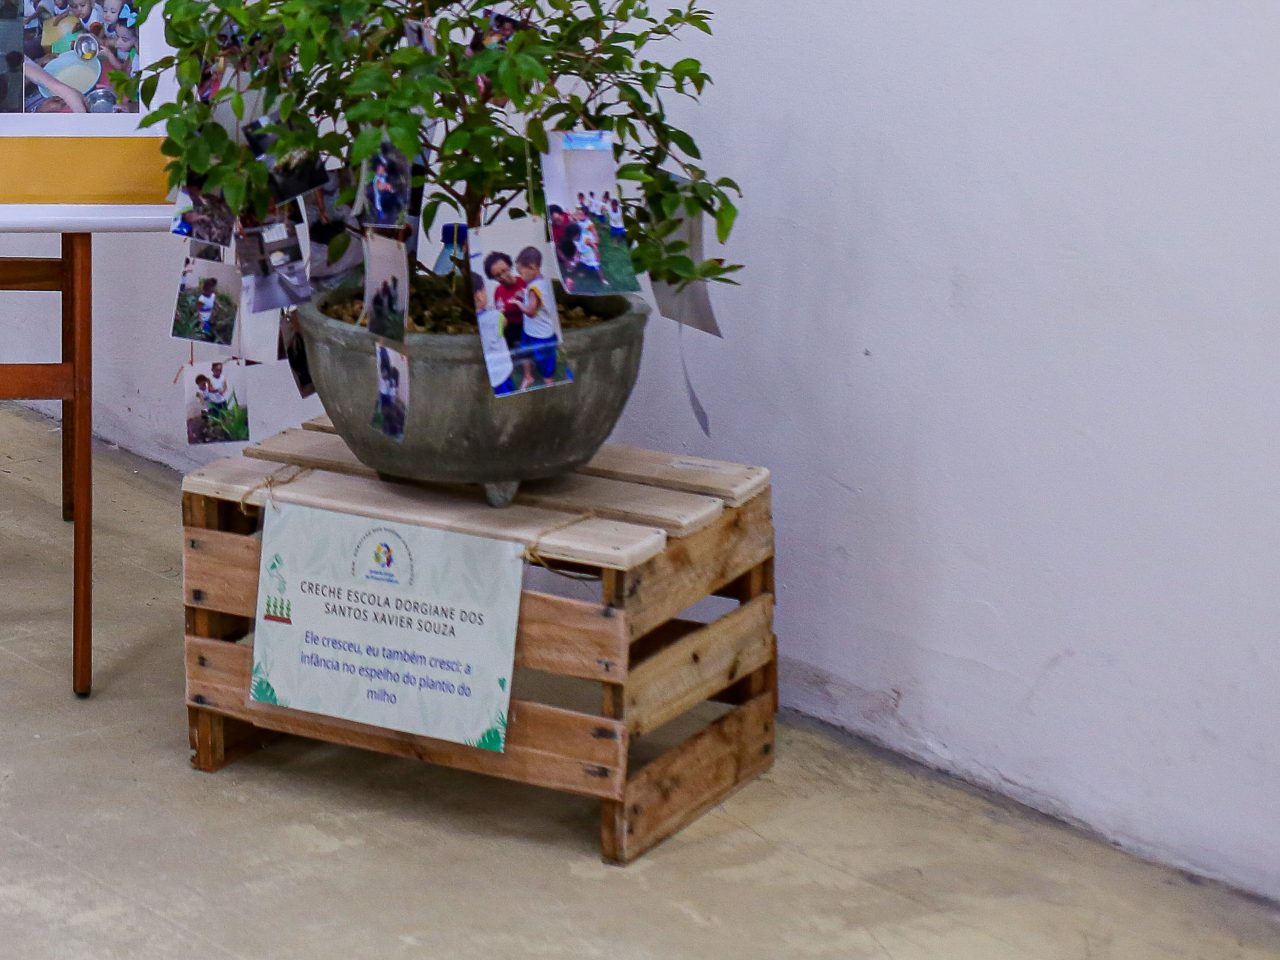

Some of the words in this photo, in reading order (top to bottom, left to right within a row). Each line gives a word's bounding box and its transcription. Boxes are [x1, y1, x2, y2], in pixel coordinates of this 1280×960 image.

[300, 580, 343, 600] CRECHE
[346, 590, 391, 609] ESCOLA
[395, 598, 456, 621] DORGIANE
[459, 609, 485, 626] DOS
[324, 602, 368, 622] SANTOS
[372, 611, 413, 630] XAVIER
[417, 619, 457, 638] SOUZA
[300, 651, 340, 672] infância
[342, 662, 356, 676] no
[358, 665, 400, 684] espelho
[402, 671, 417, 686] do
[418, 675, 456, 695] plantio
[456, 682, 472, 698] do
[304, 630, 320, 645] Ele
[365, 644, 380, 658] eu
[381, 646, 427, 667] também
[463, 662, 472, 676] a
[366, 688, 397, 705] milho
